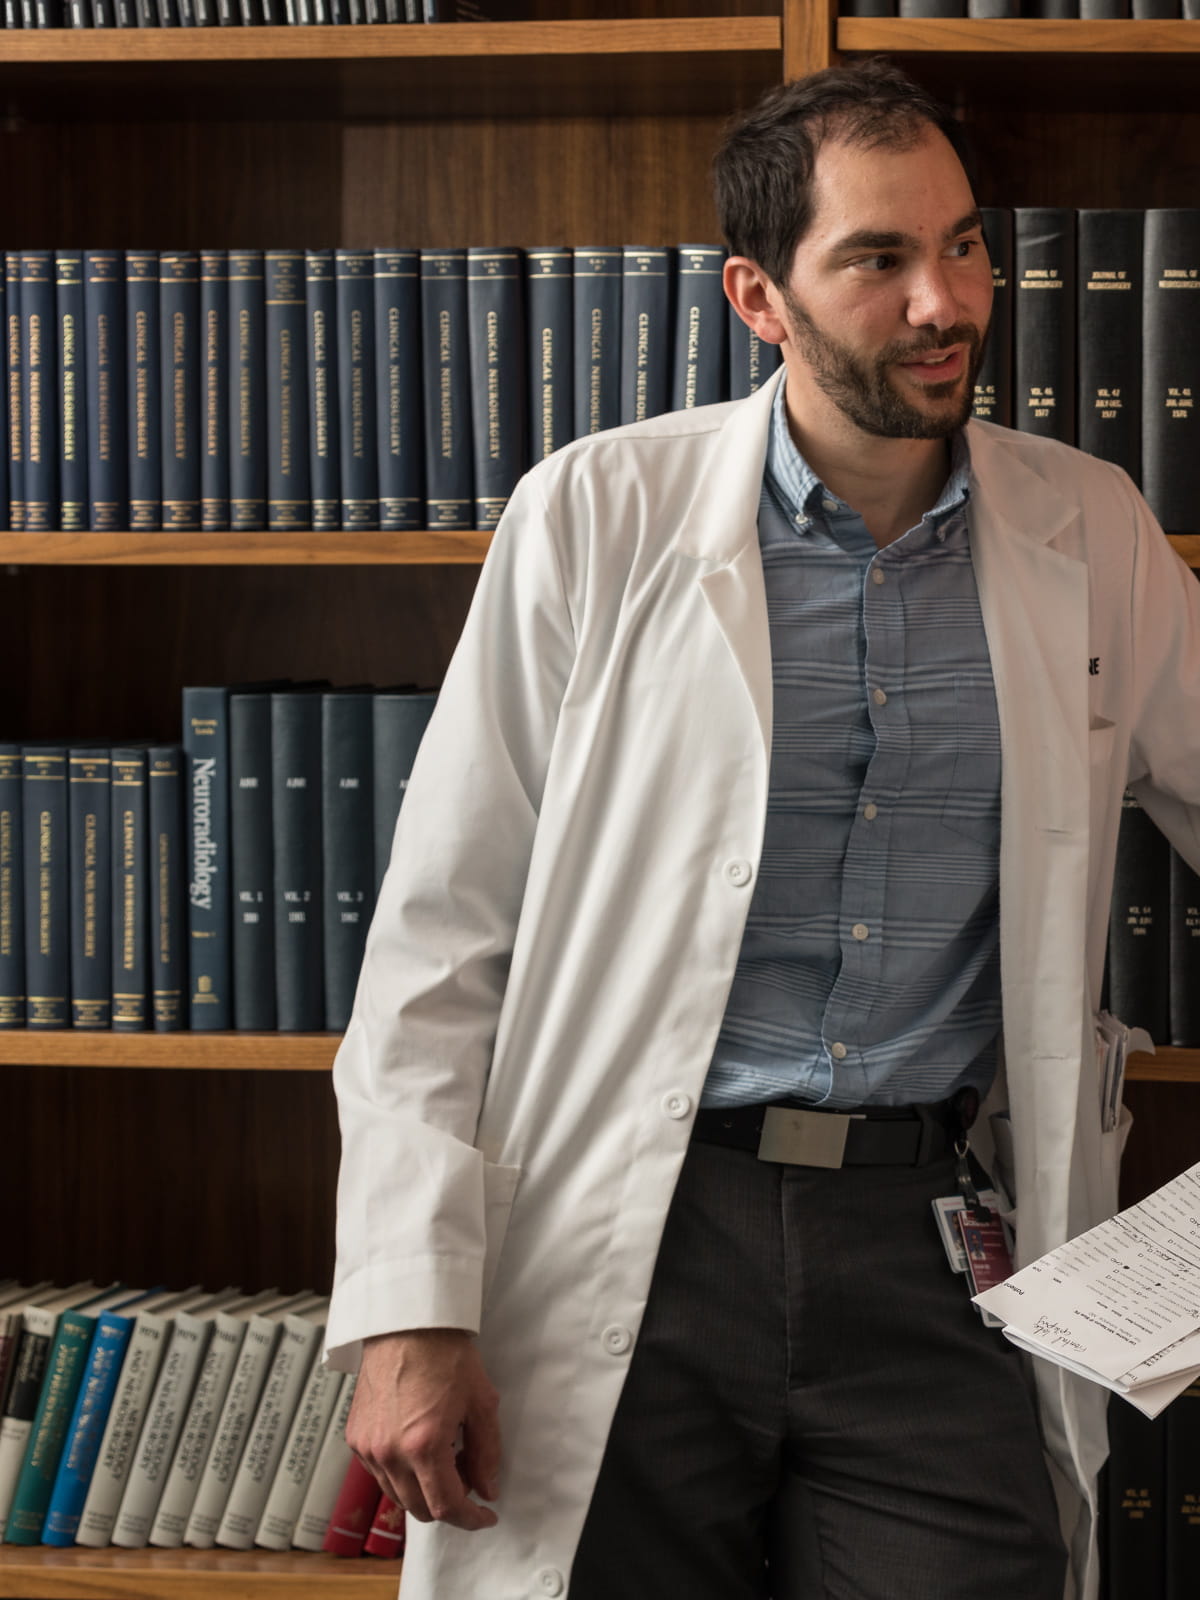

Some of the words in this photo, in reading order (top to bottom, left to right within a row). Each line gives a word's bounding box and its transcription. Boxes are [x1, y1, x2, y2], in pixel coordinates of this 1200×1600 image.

[389, 307, 399, 359] CLINICAL
[440, 310, 451, 362] CLINICAL
[488, 311, 499, 363] CLINICAL
[543, 328, 553, 381] CLINICAL
[592, 308, 602, 360] CLINICAL
[638, 313, 649, 367] CLINICAL
[688, 306, 699, 360] CLINICAL
[750, 331, 759, 379] LINICAL
[390, 365, 400, 455] NEUROSURGERY
[685, 364, 697, 408] NEUROS
[441, 368, 452, 458] NEUROSURGERY
[489, 369, 500, 459] NEUROSURGERY
[189, 758, 217, 909] Neuroradiology
